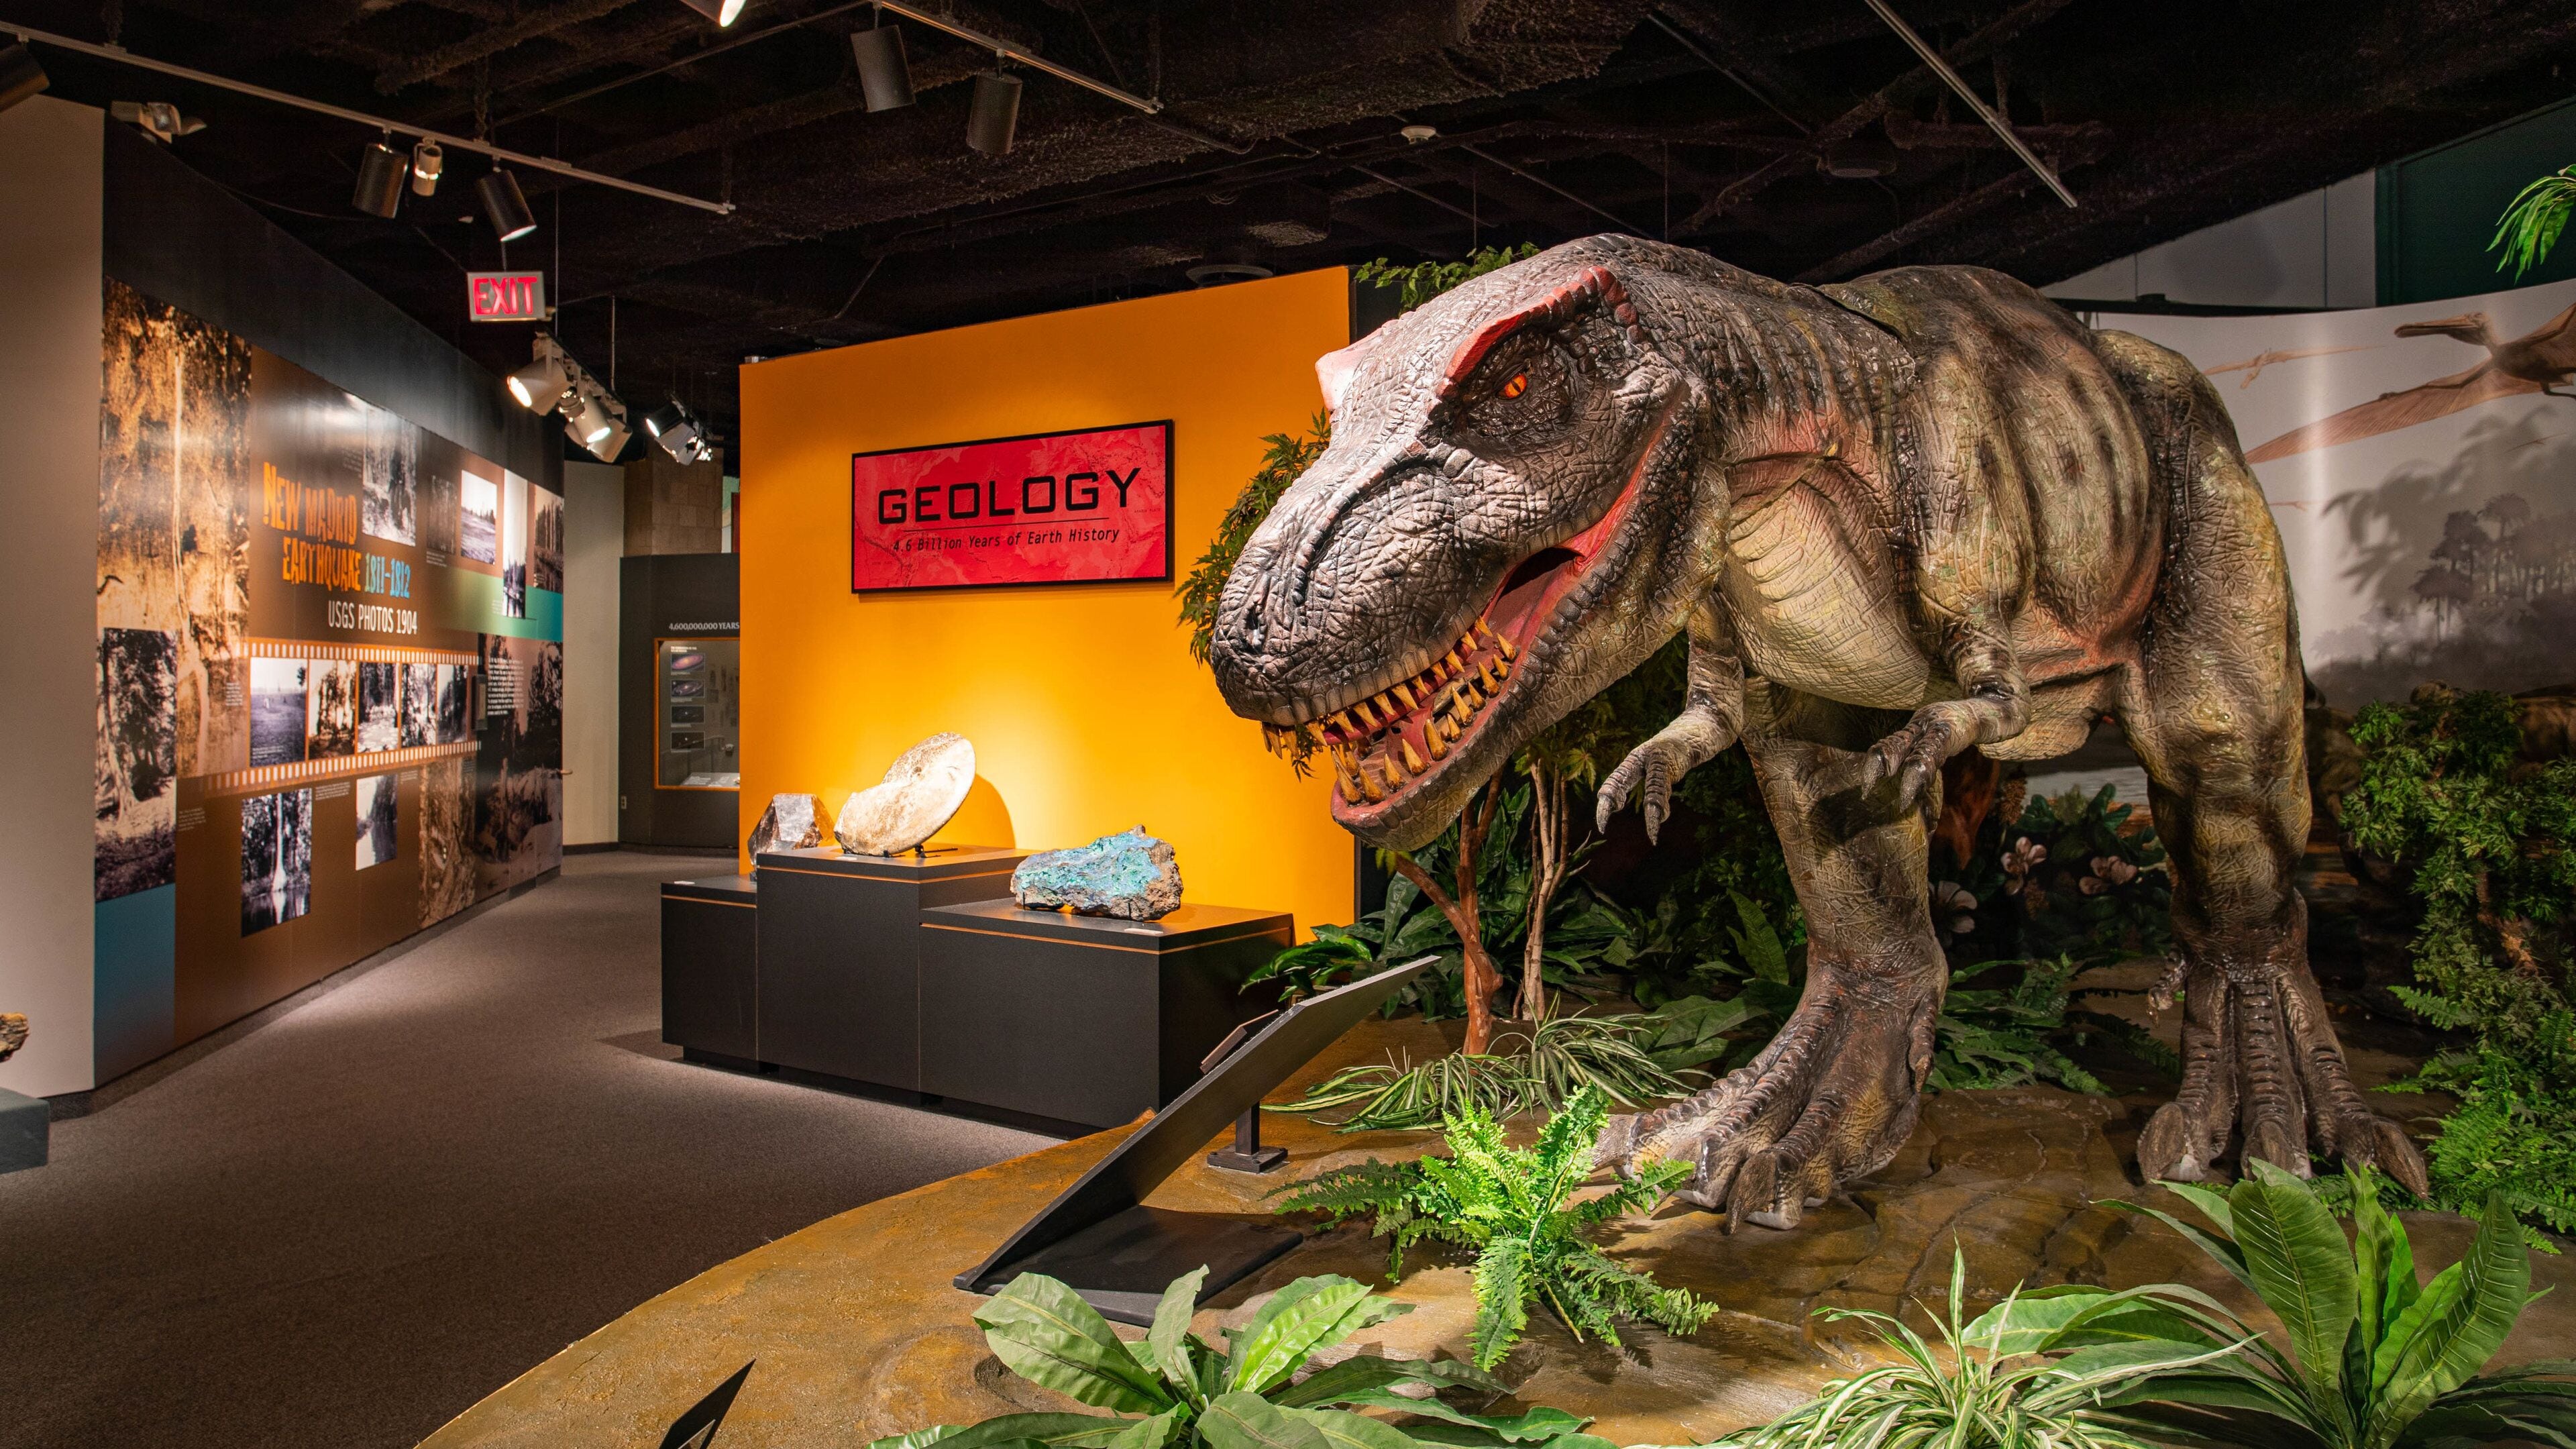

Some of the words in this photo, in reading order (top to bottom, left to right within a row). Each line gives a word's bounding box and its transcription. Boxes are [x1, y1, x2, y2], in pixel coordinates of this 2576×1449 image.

[472, 276, 537, 315] EXIT
[263, 461, 301, 531] NEW
[305, 487, 358, 545] MADRID
[878, 467, 1142, 525] GEOLOGY
[893, 538, 912, 552] 4.6
[917, 536, 962, 551] Billion
[968, 535, 1000, 548] Years
[1007, 532, 1022, 546] of
[1028, 531, 1061, 545] Earth
[1069, 528, 1120, 543] History
[282, 536, 362, 592] EARTHQUAKE
[364, 553, 411, 599] 1811-1812
[328, 600, 356, 629] USGS
[358, 604, 394, 633] PHOTOS
[396, 608, 418, 635] 1904
[669, 623, 718, 631] 4,600,000,000
[718, 622, 740, 630] YEARS
